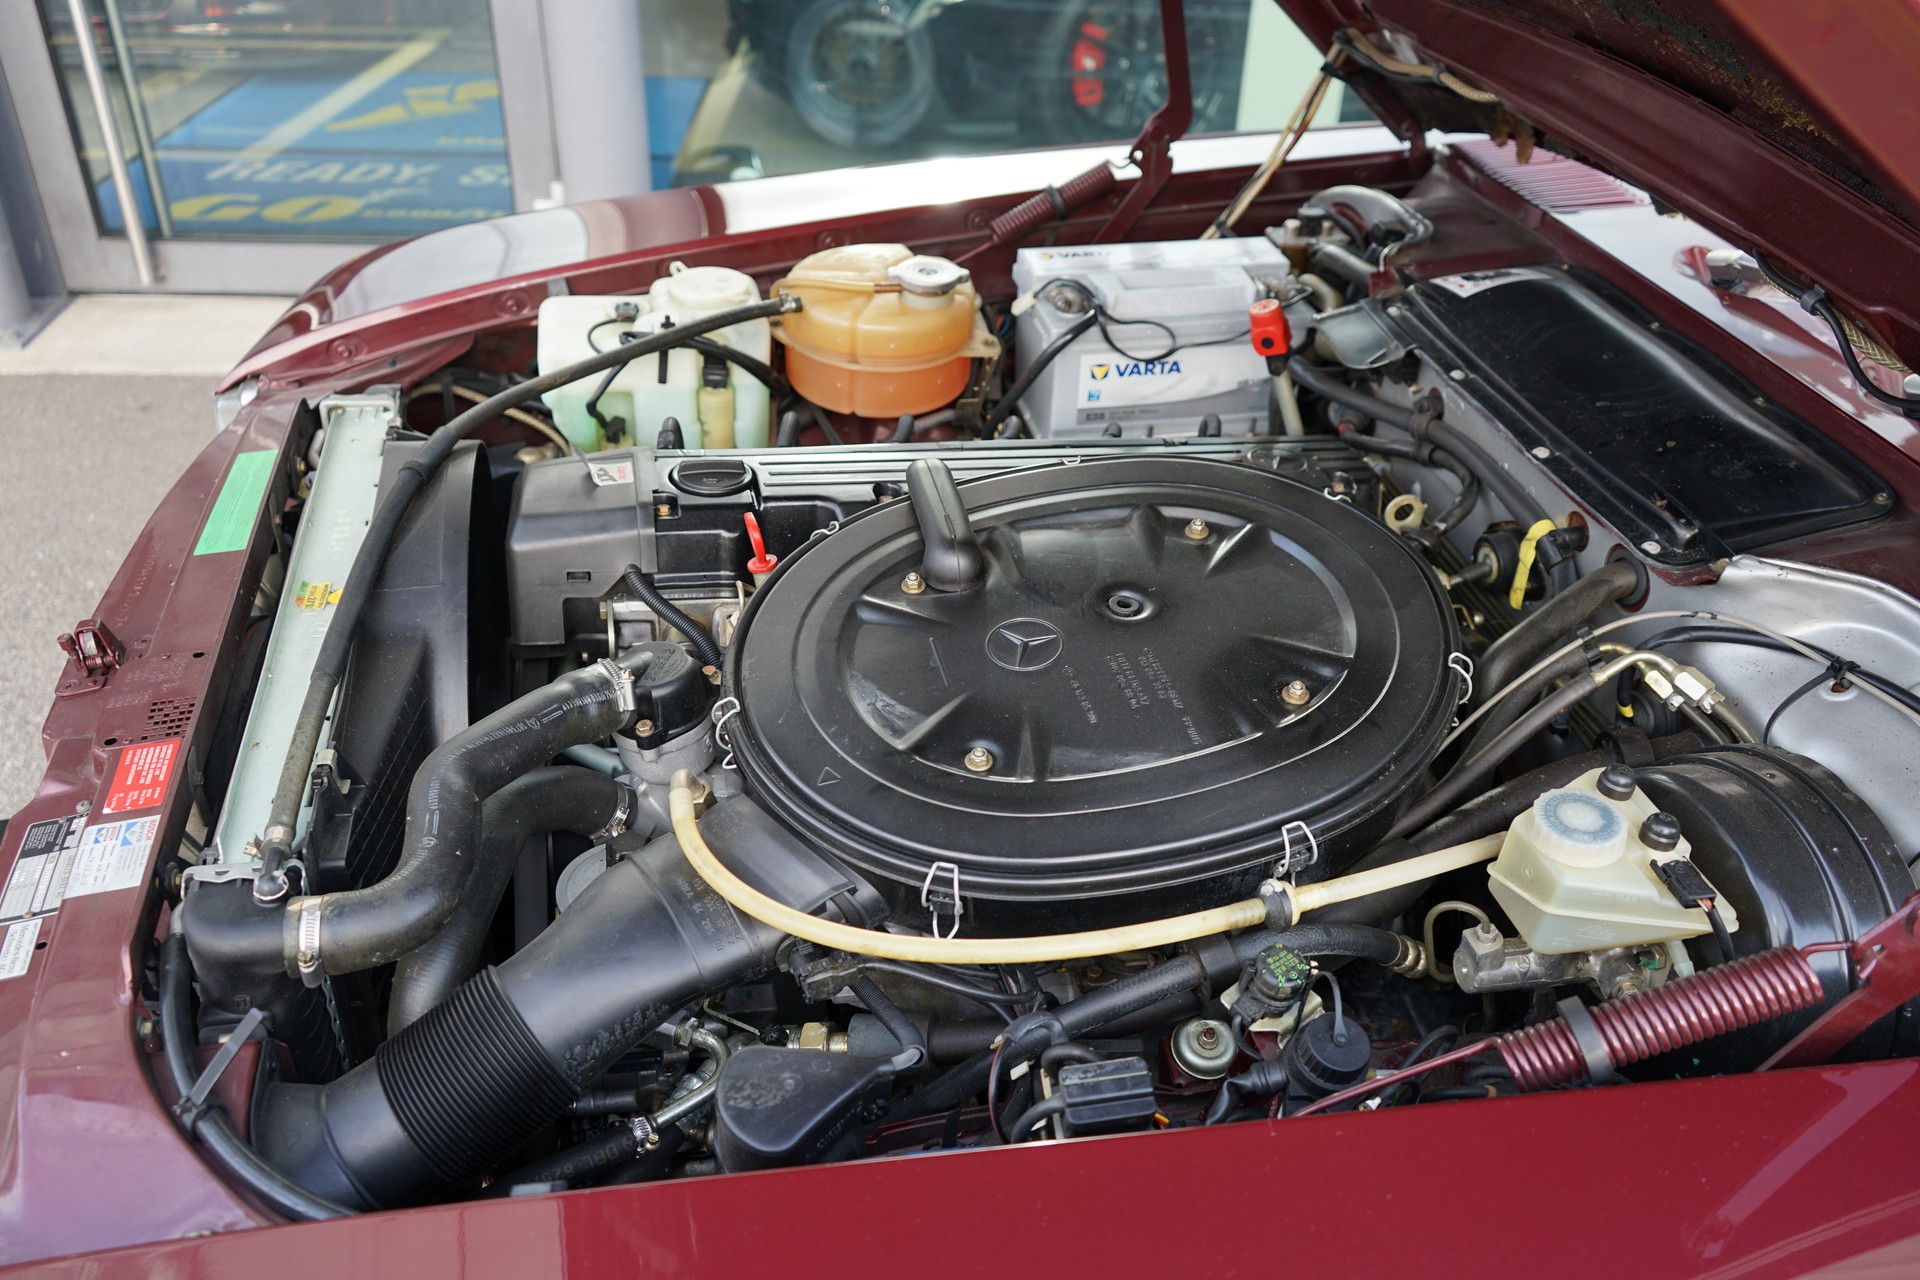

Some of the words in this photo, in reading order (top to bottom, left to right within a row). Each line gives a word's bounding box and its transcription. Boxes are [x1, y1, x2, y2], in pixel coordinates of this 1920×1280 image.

[1116, 360, 1181, 377] VARTA
[136, 820, 148, 842] Service
[145, 819, 158, 841] BOSCH
